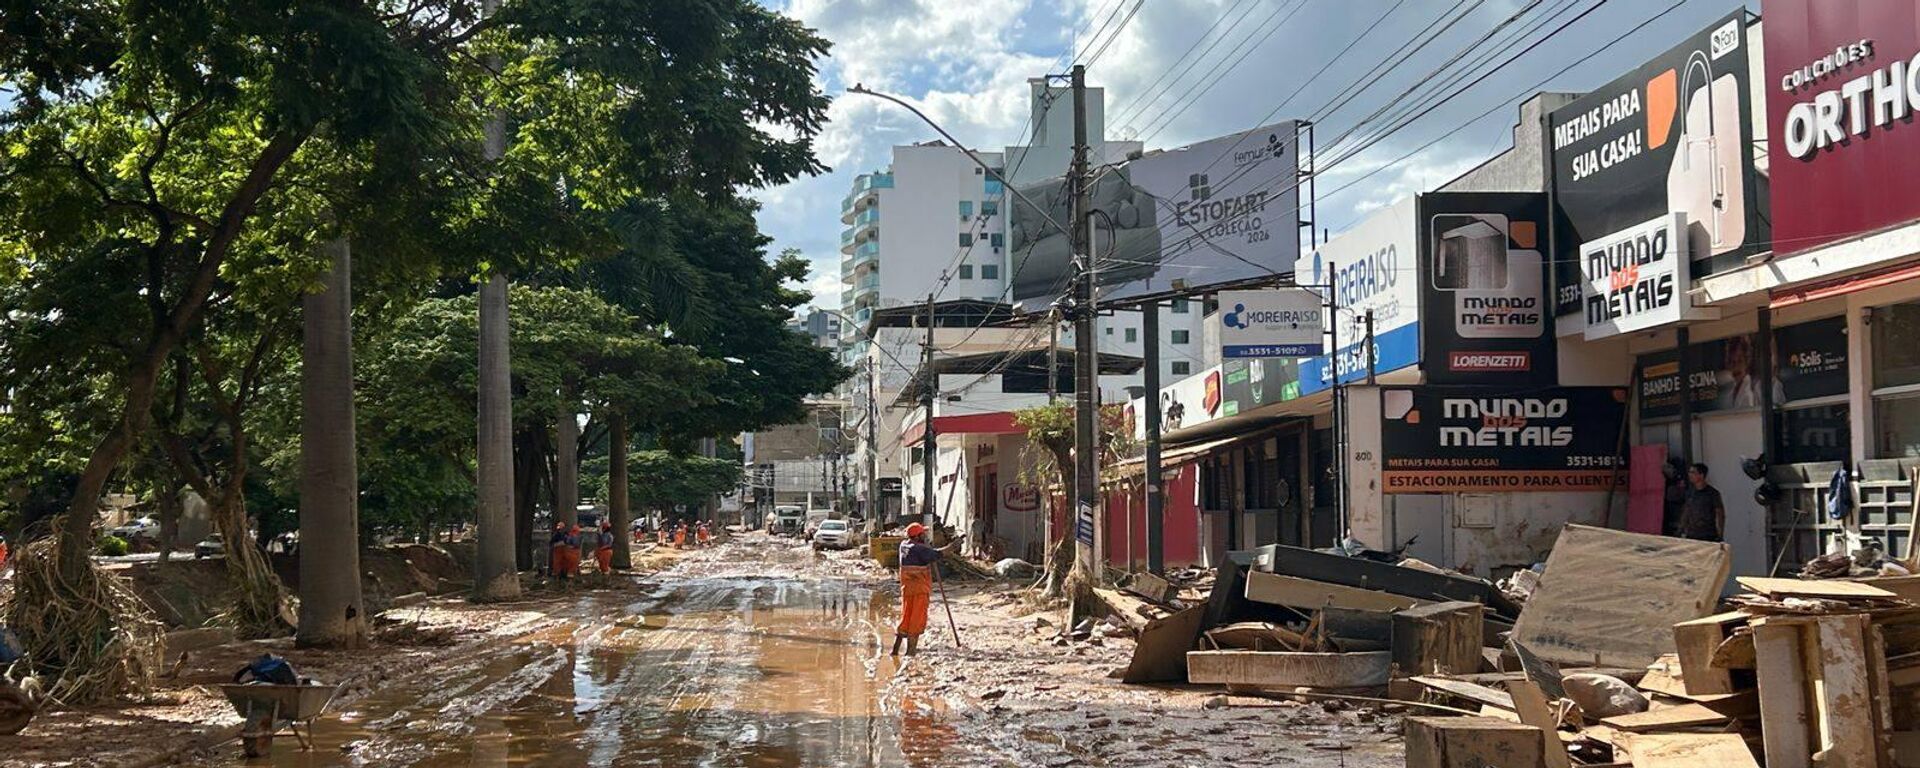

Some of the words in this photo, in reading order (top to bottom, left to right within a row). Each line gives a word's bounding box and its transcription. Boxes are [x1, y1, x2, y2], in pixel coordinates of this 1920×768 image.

[1782, 39, 1871, 92] COLCHÕES
[1554, 107, 1601, 151] METAIS
[1603, 88, 1641, 128] PARA
[1572, 149, 1600, 182] SUA
[1601, 128, 1642, 169] CASA!
[1176, 190, 1270, 228] ESTOFART
[1208, 216, 1263, 240] COLEÇÃO
[1247, 230, 1270, 245] 2026
[1588, 227, 1668, 282] MUNDO
[1611, 263, 1639, 291] DOS
[1463, 297, 1536, 309] MUNDO
[1588, 272, 1673, 325] METAIS
[1246, 310, 1319, 324] MOREIRAISO
[1461, 313, 1539, 325] METAIS
[1453, 355, 1526, 367] LORENZETTI
[1800, 350, 1822, 368] Solis
[1688, 370, 1718, 389] SCINA
[1443, 399, 1568, 419] MUNDO
[1483, 416, 1528, 428] DOS
[1439, 427, 1573, 447] METAIS
[1388, 458, 1423, 467] METAIS
[1424, 458, 1450, 467] PARA
[1450, 458, 1470, 467] SUA
[1471, 458, 1500, 467] CASA!
[1389, 475, 1520, 487] ESTACIONAMENTO
[1523, 475, 1562, 487] PARA
[1564, 475, 1626, 487] CLIENTS
